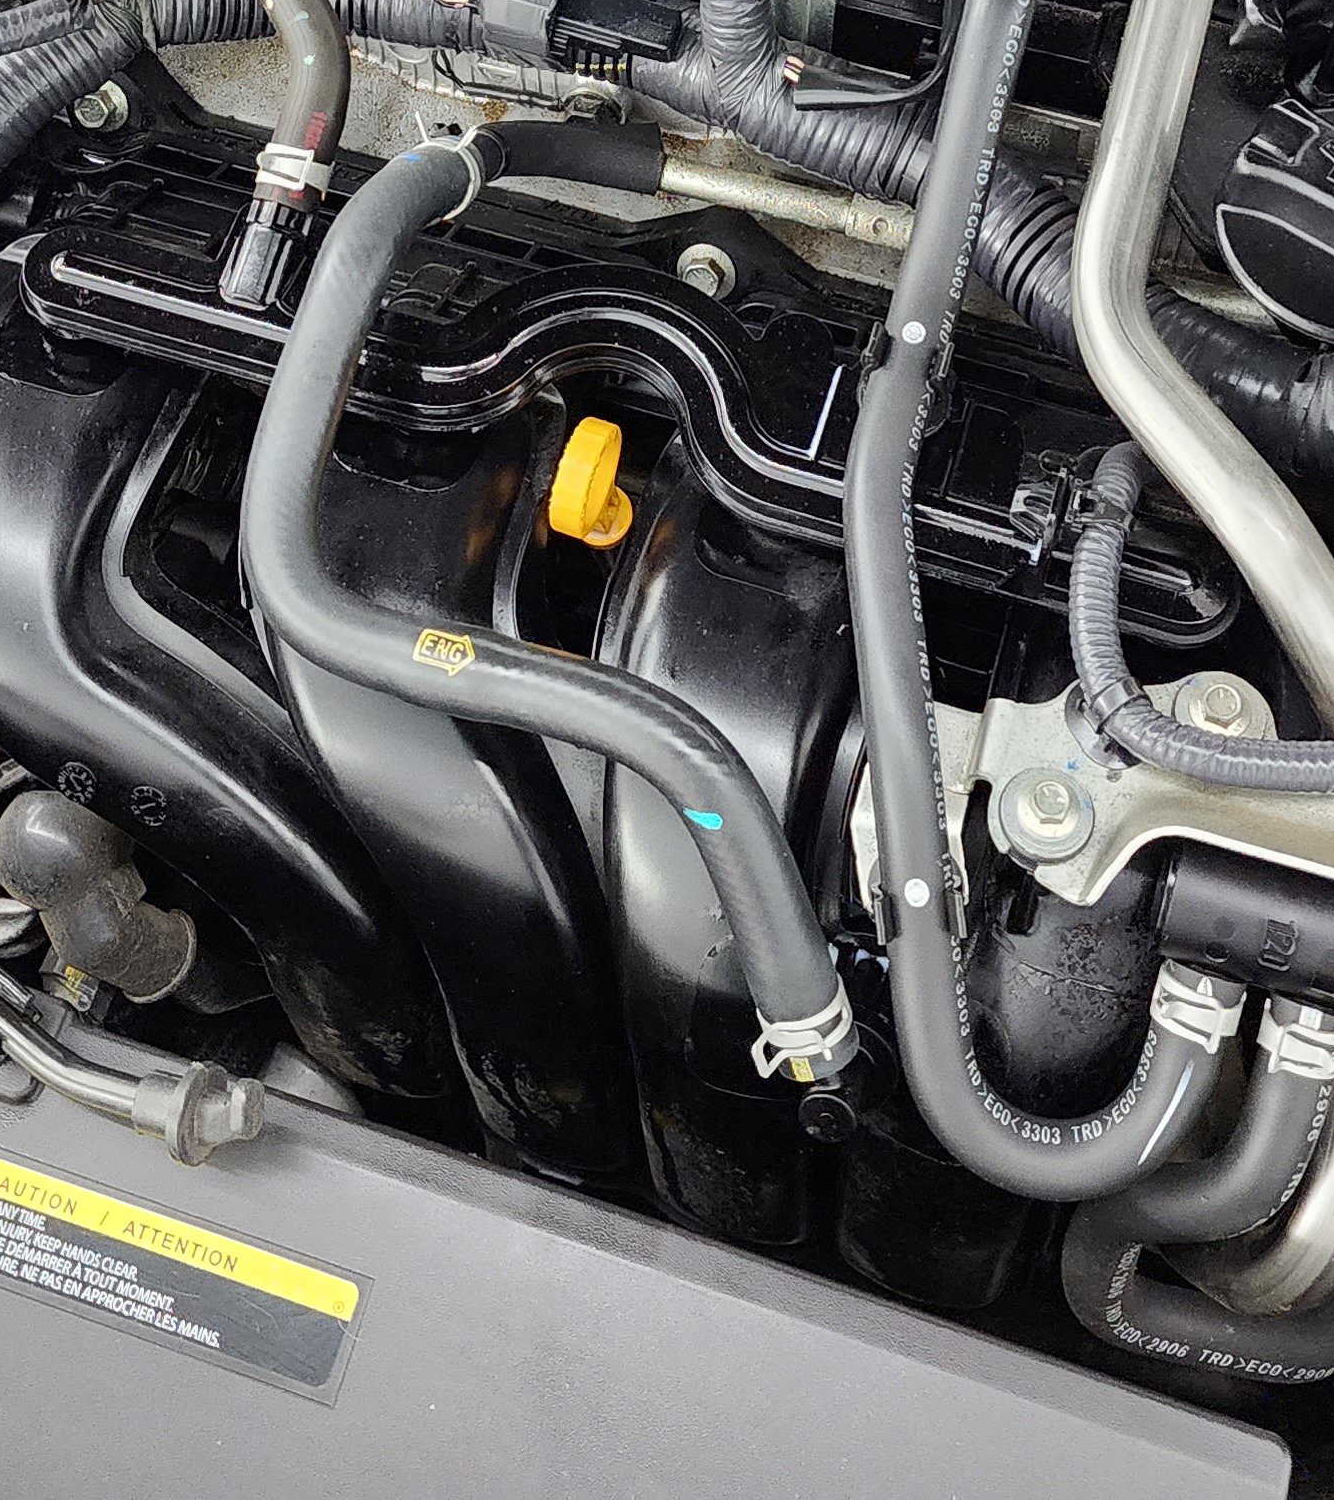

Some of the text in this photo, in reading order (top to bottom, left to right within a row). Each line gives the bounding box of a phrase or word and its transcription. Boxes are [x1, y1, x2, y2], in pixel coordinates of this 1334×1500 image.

[420, 633, 465, 664] ENG
[32, 1232, 62, 1253] KEEP
[59, 1242, 102, 1269] HANDS
[100, 1256, 140, 1282] CLEAR.
[99, 1210, 109, 1226] /
[121, 1219, 239, 1272] ATTENTION
[4, 1238, 74, 1275] DÉMARRER
[71, 1261, 84, 1278] À
[82, 1267, 118, 1290] TOUT
[115, 1280, 176, 1312] MOMENT.
[19, 1262, 40, 1282] NE
[37, 1270, 63, 1290] PAS
[61, 1278, 82, 1297] EN
[82, 1286, 159, 1324] APPROCHER
[154, 1311, 178, 1331] LES
[175, 1319, 223, 1348] MAINS.
